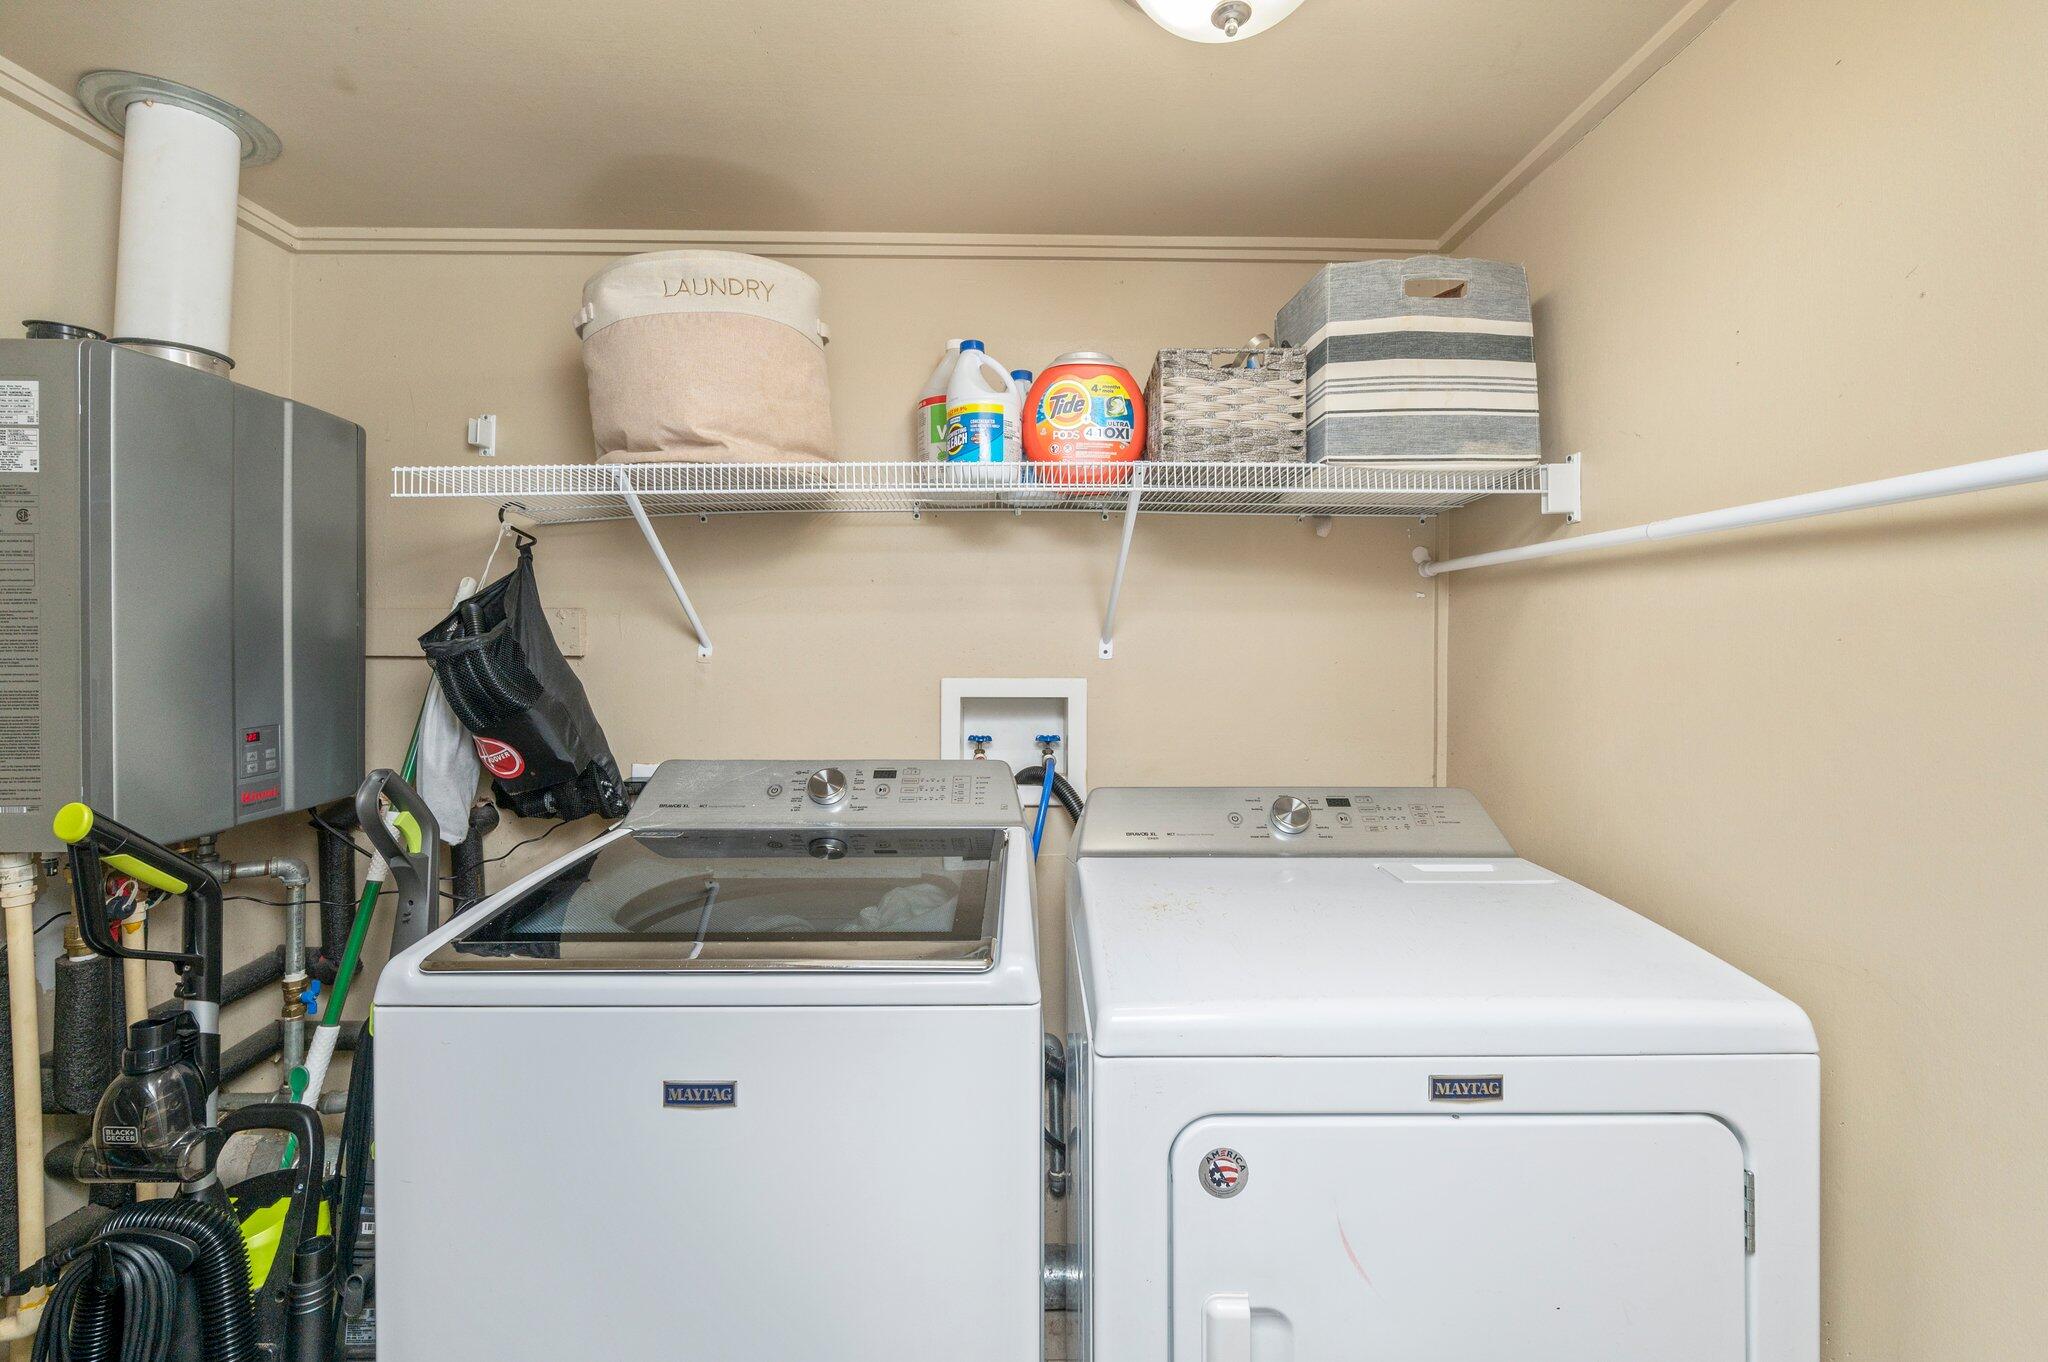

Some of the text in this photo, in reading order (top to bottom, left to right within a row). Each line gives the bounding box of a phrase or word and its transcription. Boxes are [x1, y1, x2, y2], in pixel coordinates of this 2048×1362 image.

[663, 278, 775, 302] LAUNDRY
[1050, 391, 1086, 420] Tide
[936, 425, 948, 440] V
[1052, 430, 1081, 440] PODS
[1104, 427, 1130, 440] OXI
[947, 432, 968, 451] LEACH
[667, 1087, 732, 1101] MAYTAG
[1435, 1082, 1500, 1095] MAYTAG
[1206, 1149, 1247, 1173] AMERICA
